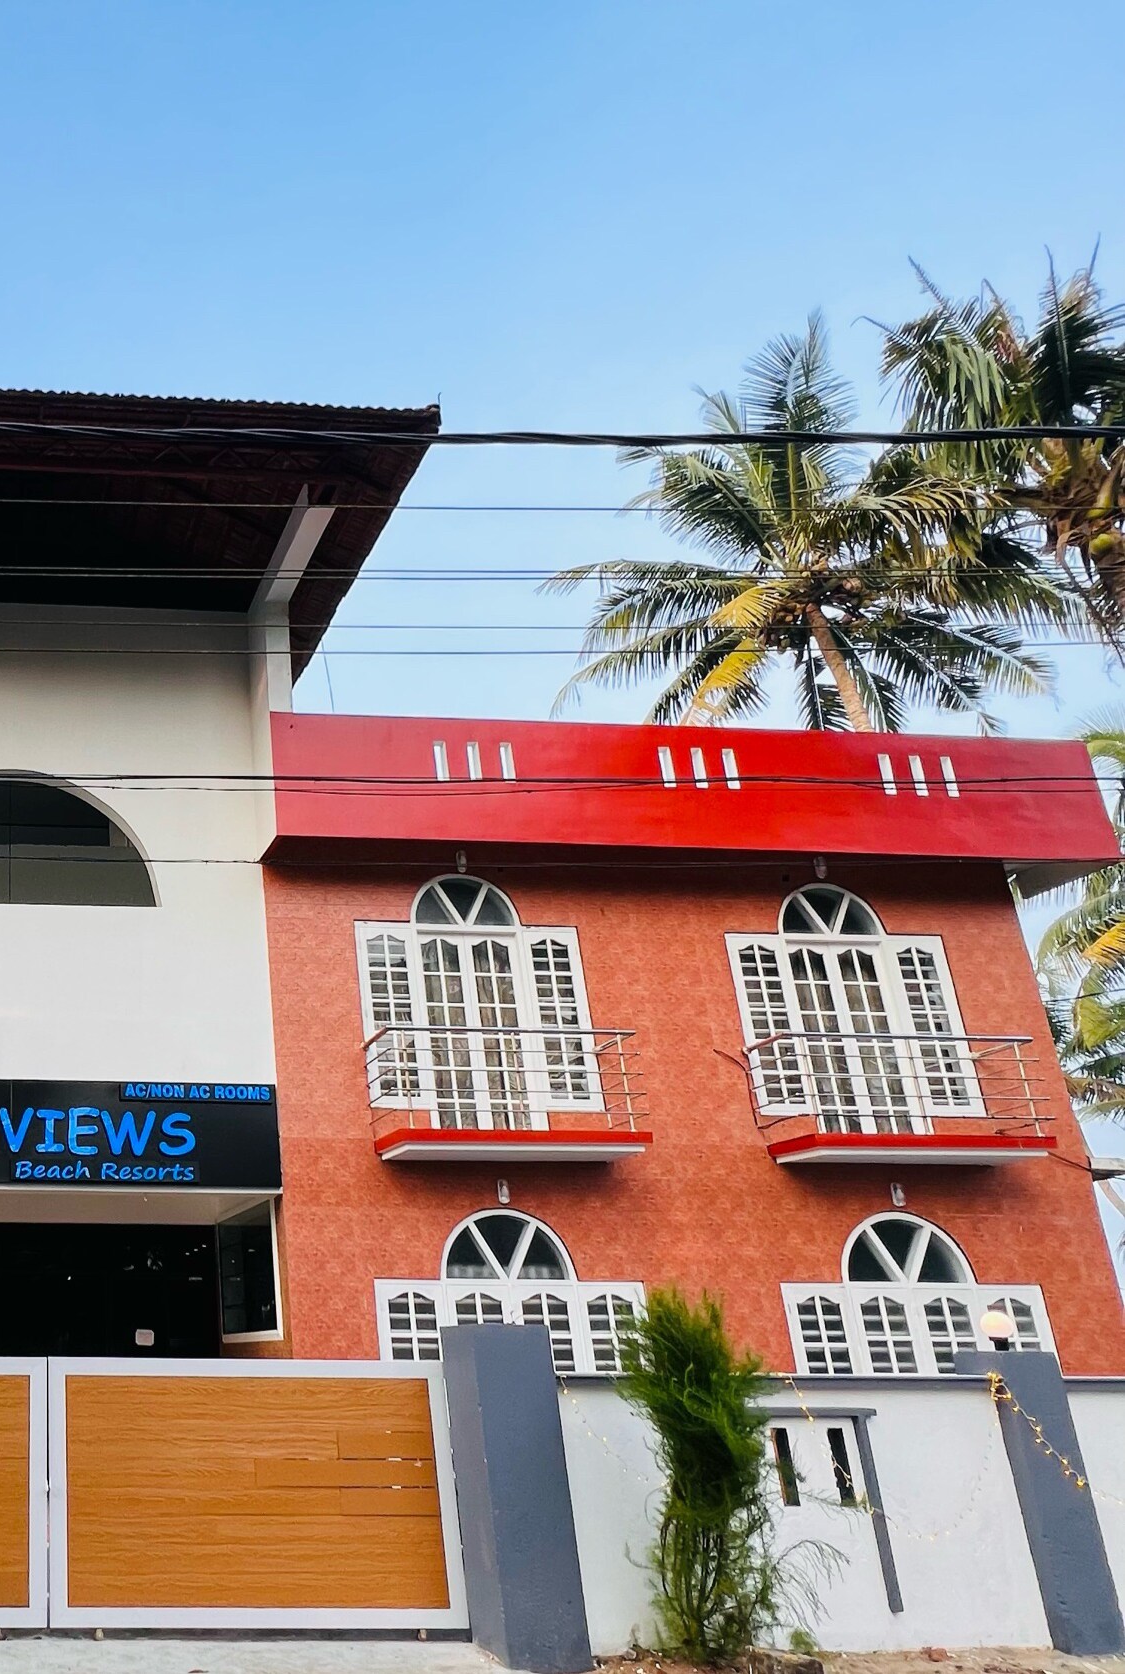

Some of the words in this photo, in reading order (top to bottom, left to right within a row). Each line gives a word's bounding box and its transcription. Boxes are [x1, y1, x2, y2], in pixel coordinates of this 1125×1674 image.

[124, 1084, 186, 1098] AC/NON
[189, 1085, 210, 1099] AC
[214, 1085, 271, 1100] ROOMS
[0, 1106, 196, 1155] VIEWS
[15, 1160, 90, 1180] Beach
[101, 1162, 195, 1181] Resorts
